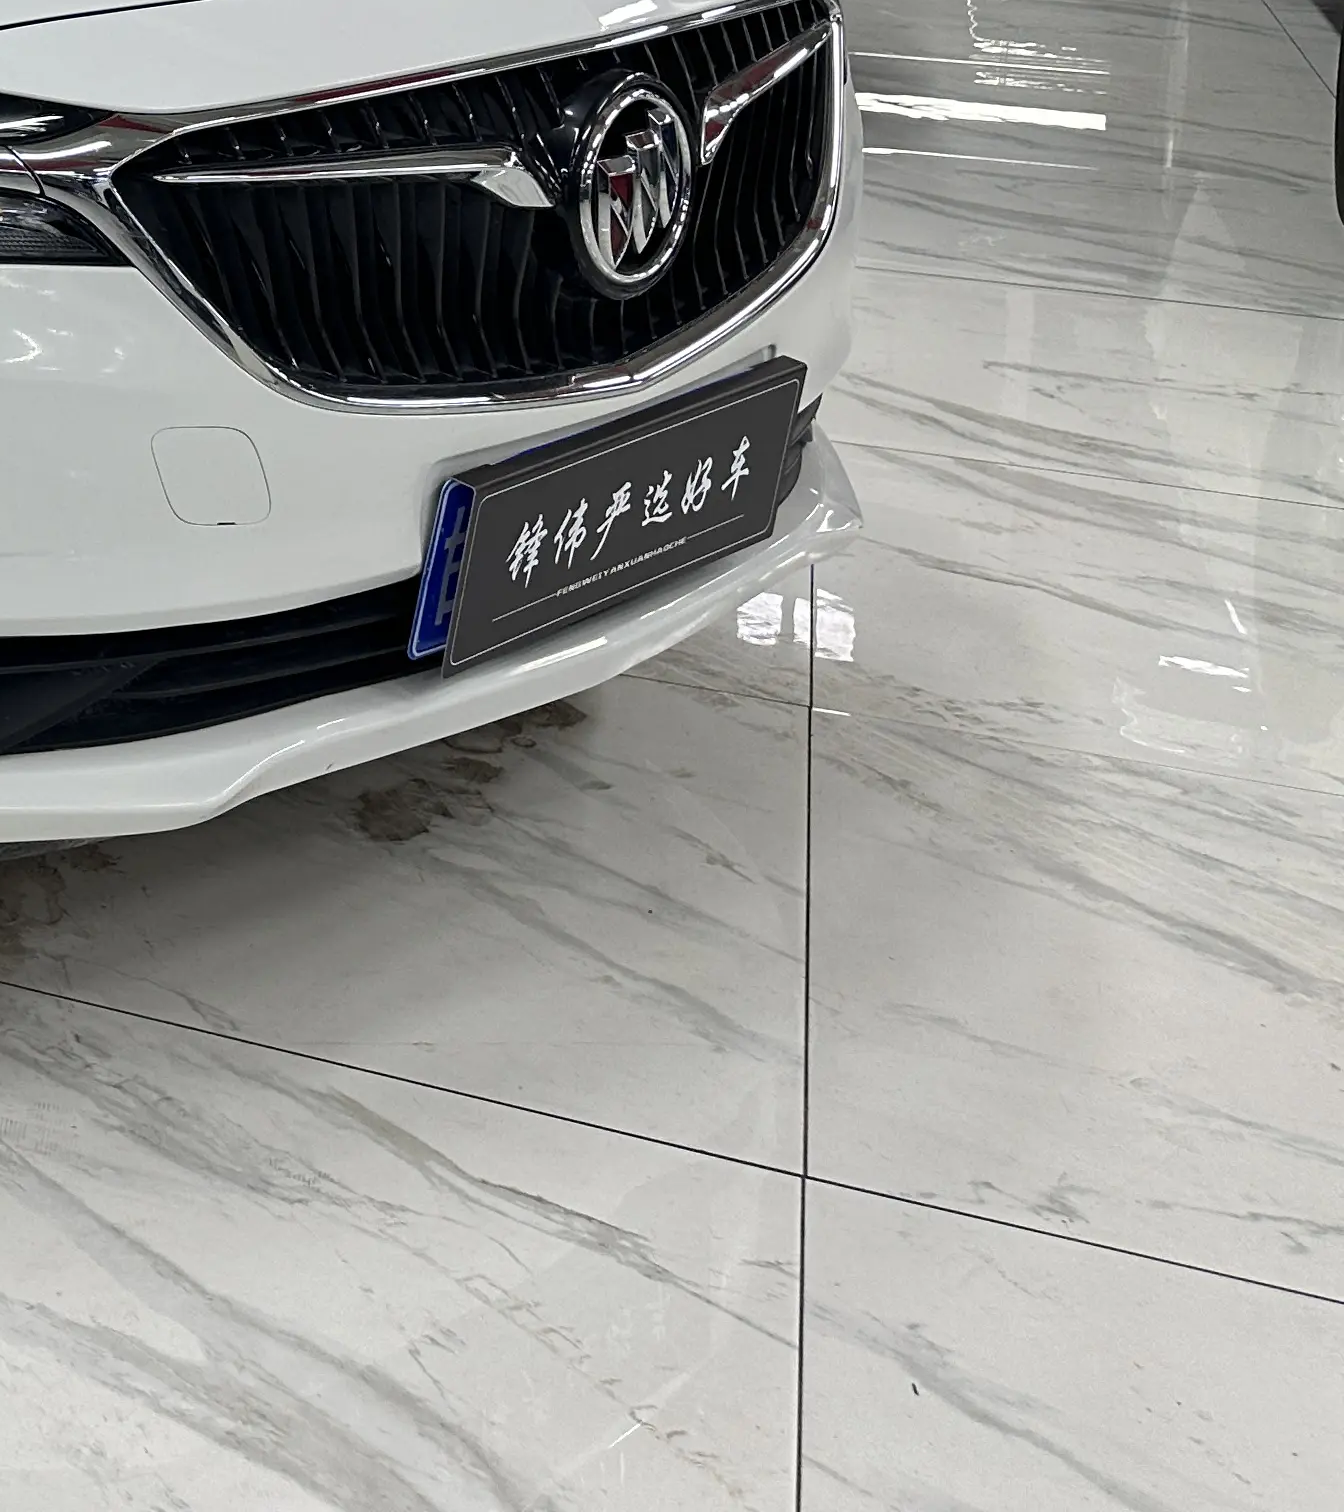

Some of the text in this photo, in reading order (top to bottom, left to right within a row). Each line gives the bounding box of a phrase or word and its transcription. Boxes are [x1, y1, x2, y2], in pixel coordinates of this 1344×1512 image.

[505, 435, 752, 588] 锋伟严选好车
